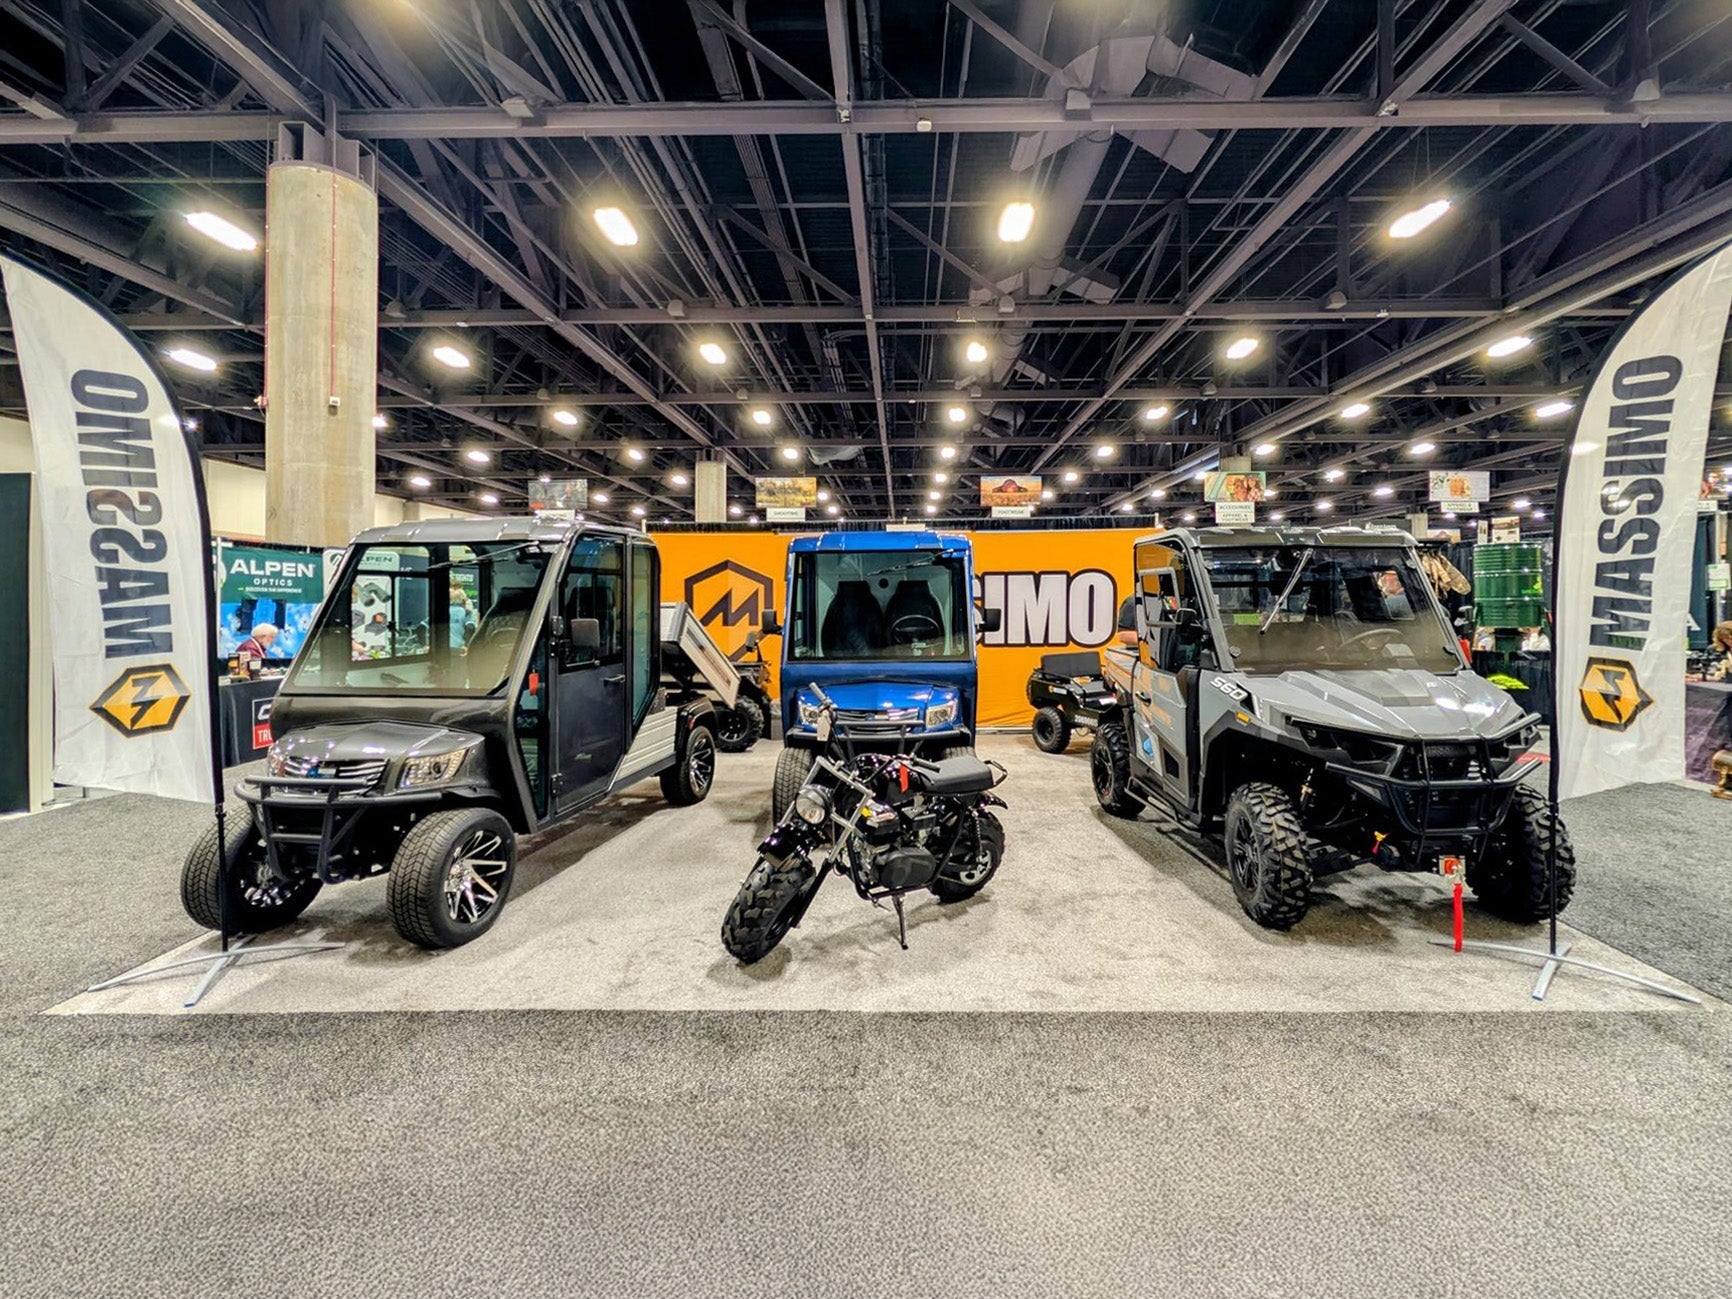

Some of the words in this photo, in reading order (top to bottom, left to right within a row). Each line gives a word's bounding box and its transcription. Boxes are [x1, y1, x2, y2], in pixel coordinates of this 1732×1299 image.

[1589, 355, 1683, 651] MASSIMO
[230, 559, 314, 578] ALPEN
[253, 578, 293, 587] OPTICS
